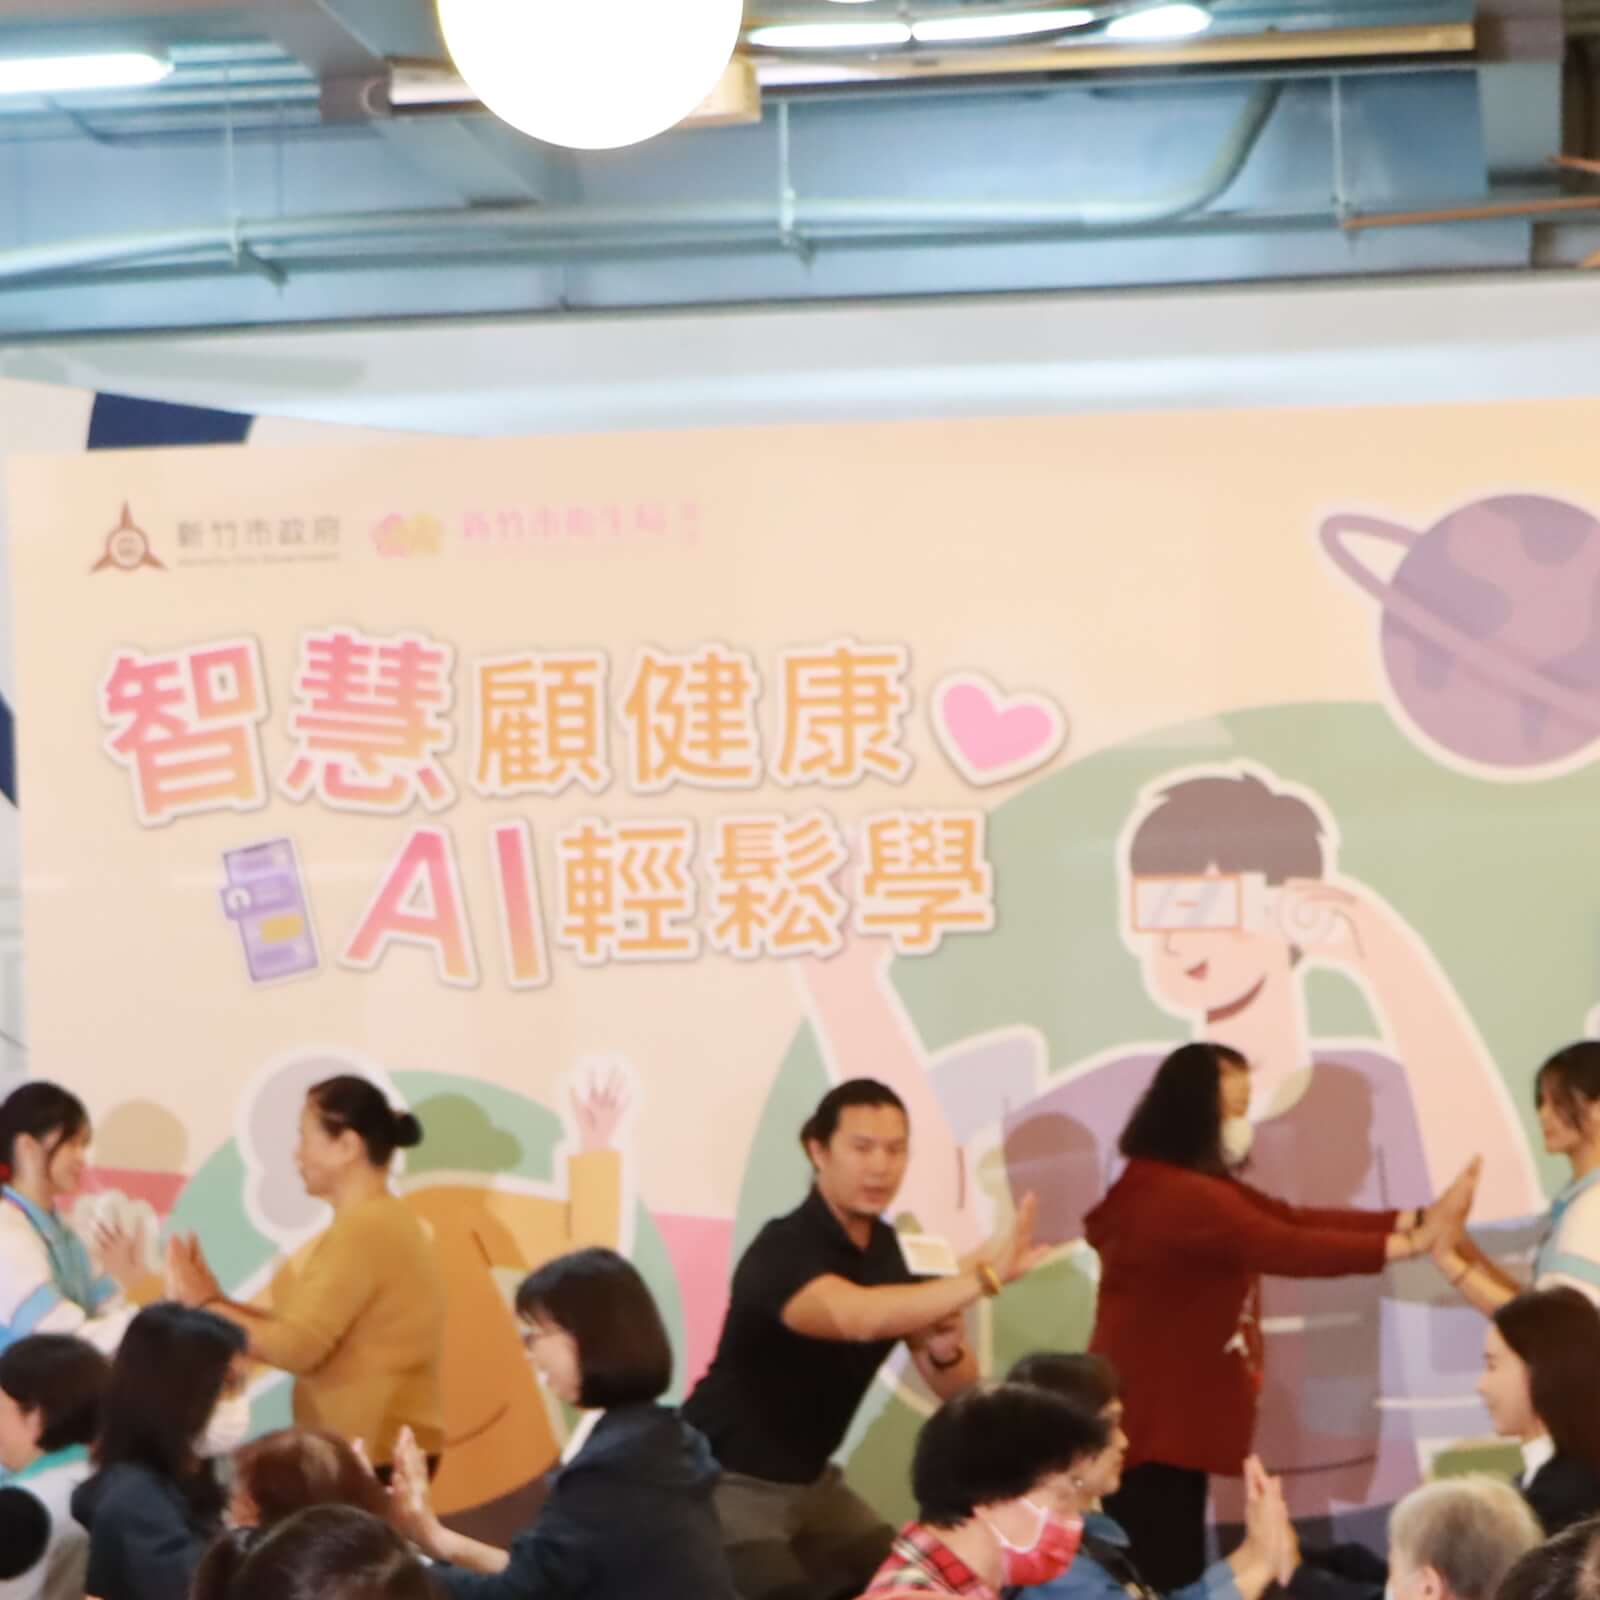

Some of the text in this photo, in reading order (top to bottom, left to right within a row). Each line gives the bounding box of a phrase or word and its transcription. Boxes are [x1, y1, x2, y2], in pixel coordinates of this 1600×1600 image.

[103, 630, 910, 820] 智慧顧健康
[342, 812, 992, 984] AI輕鬆學
